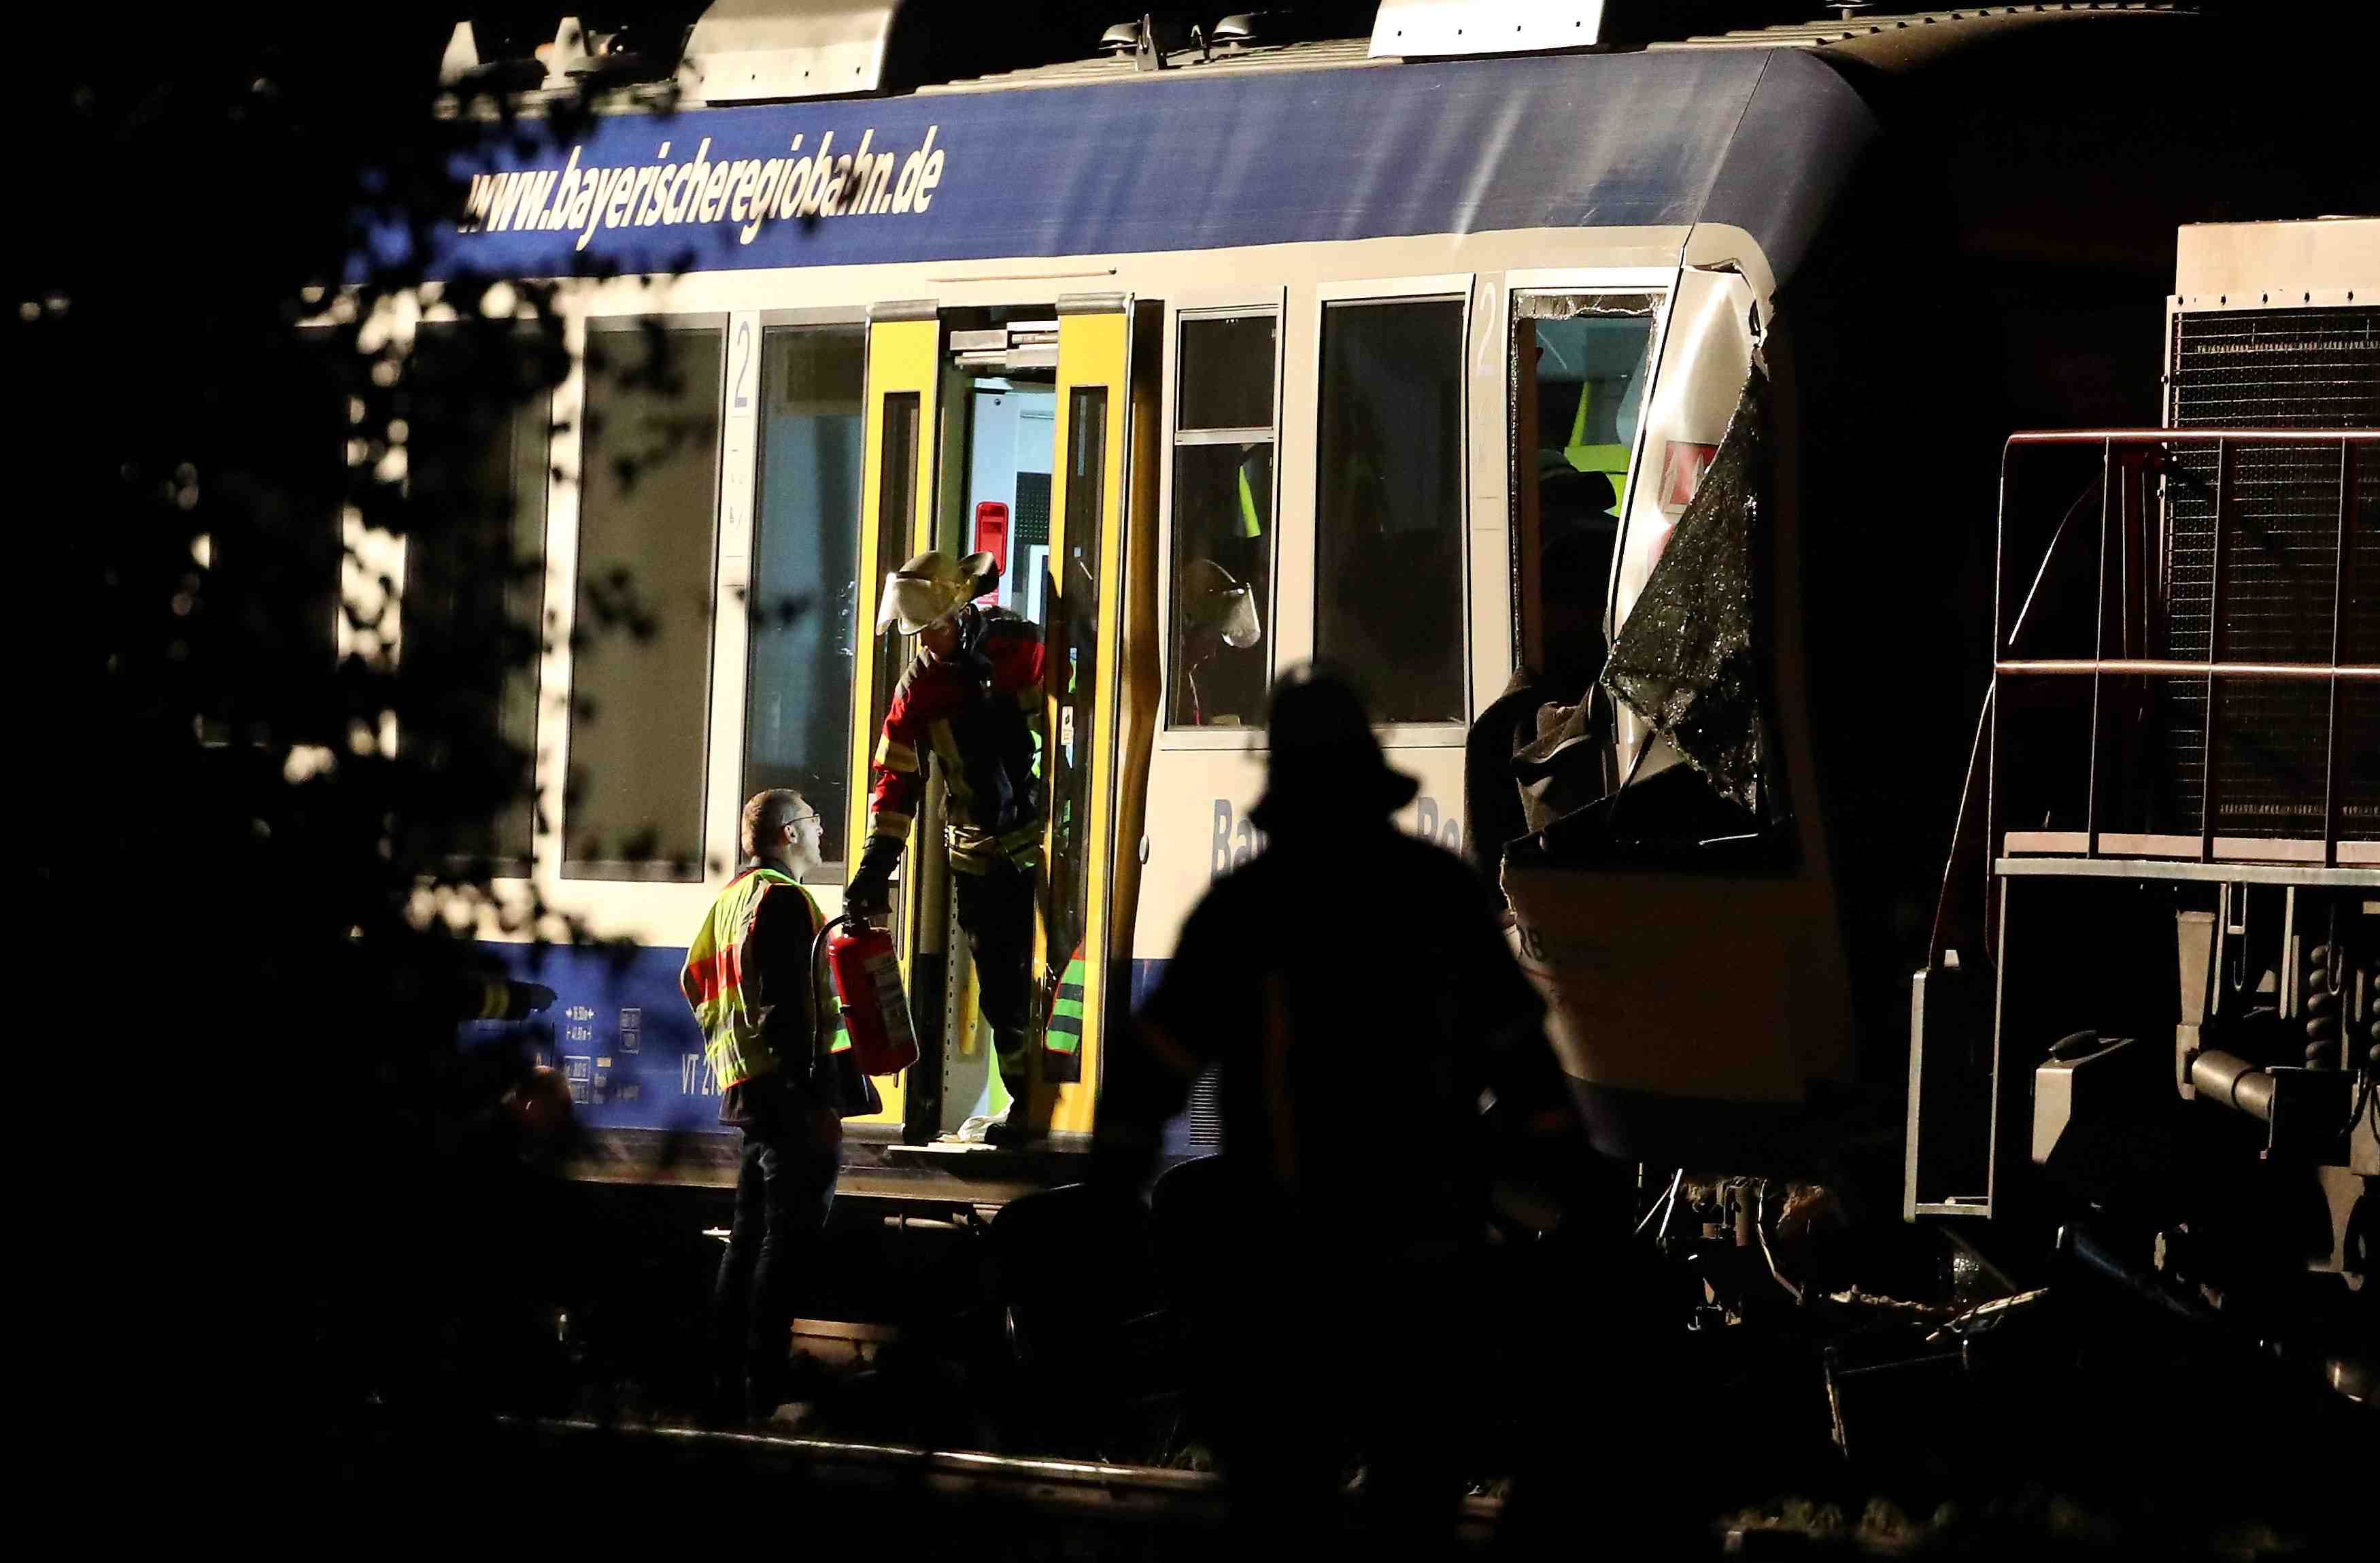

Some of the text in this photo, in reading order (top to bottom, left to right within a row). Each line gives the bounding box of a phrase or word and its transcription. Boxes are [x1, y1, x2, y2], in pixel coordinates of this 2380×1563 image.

[458, 124, 945, 251] www.bayerischeregiobahn.de
[734, 320, 750, 407] 2
[1477, 281, 1497, 377] 2
[681, 1054, 700, 1094] VT
